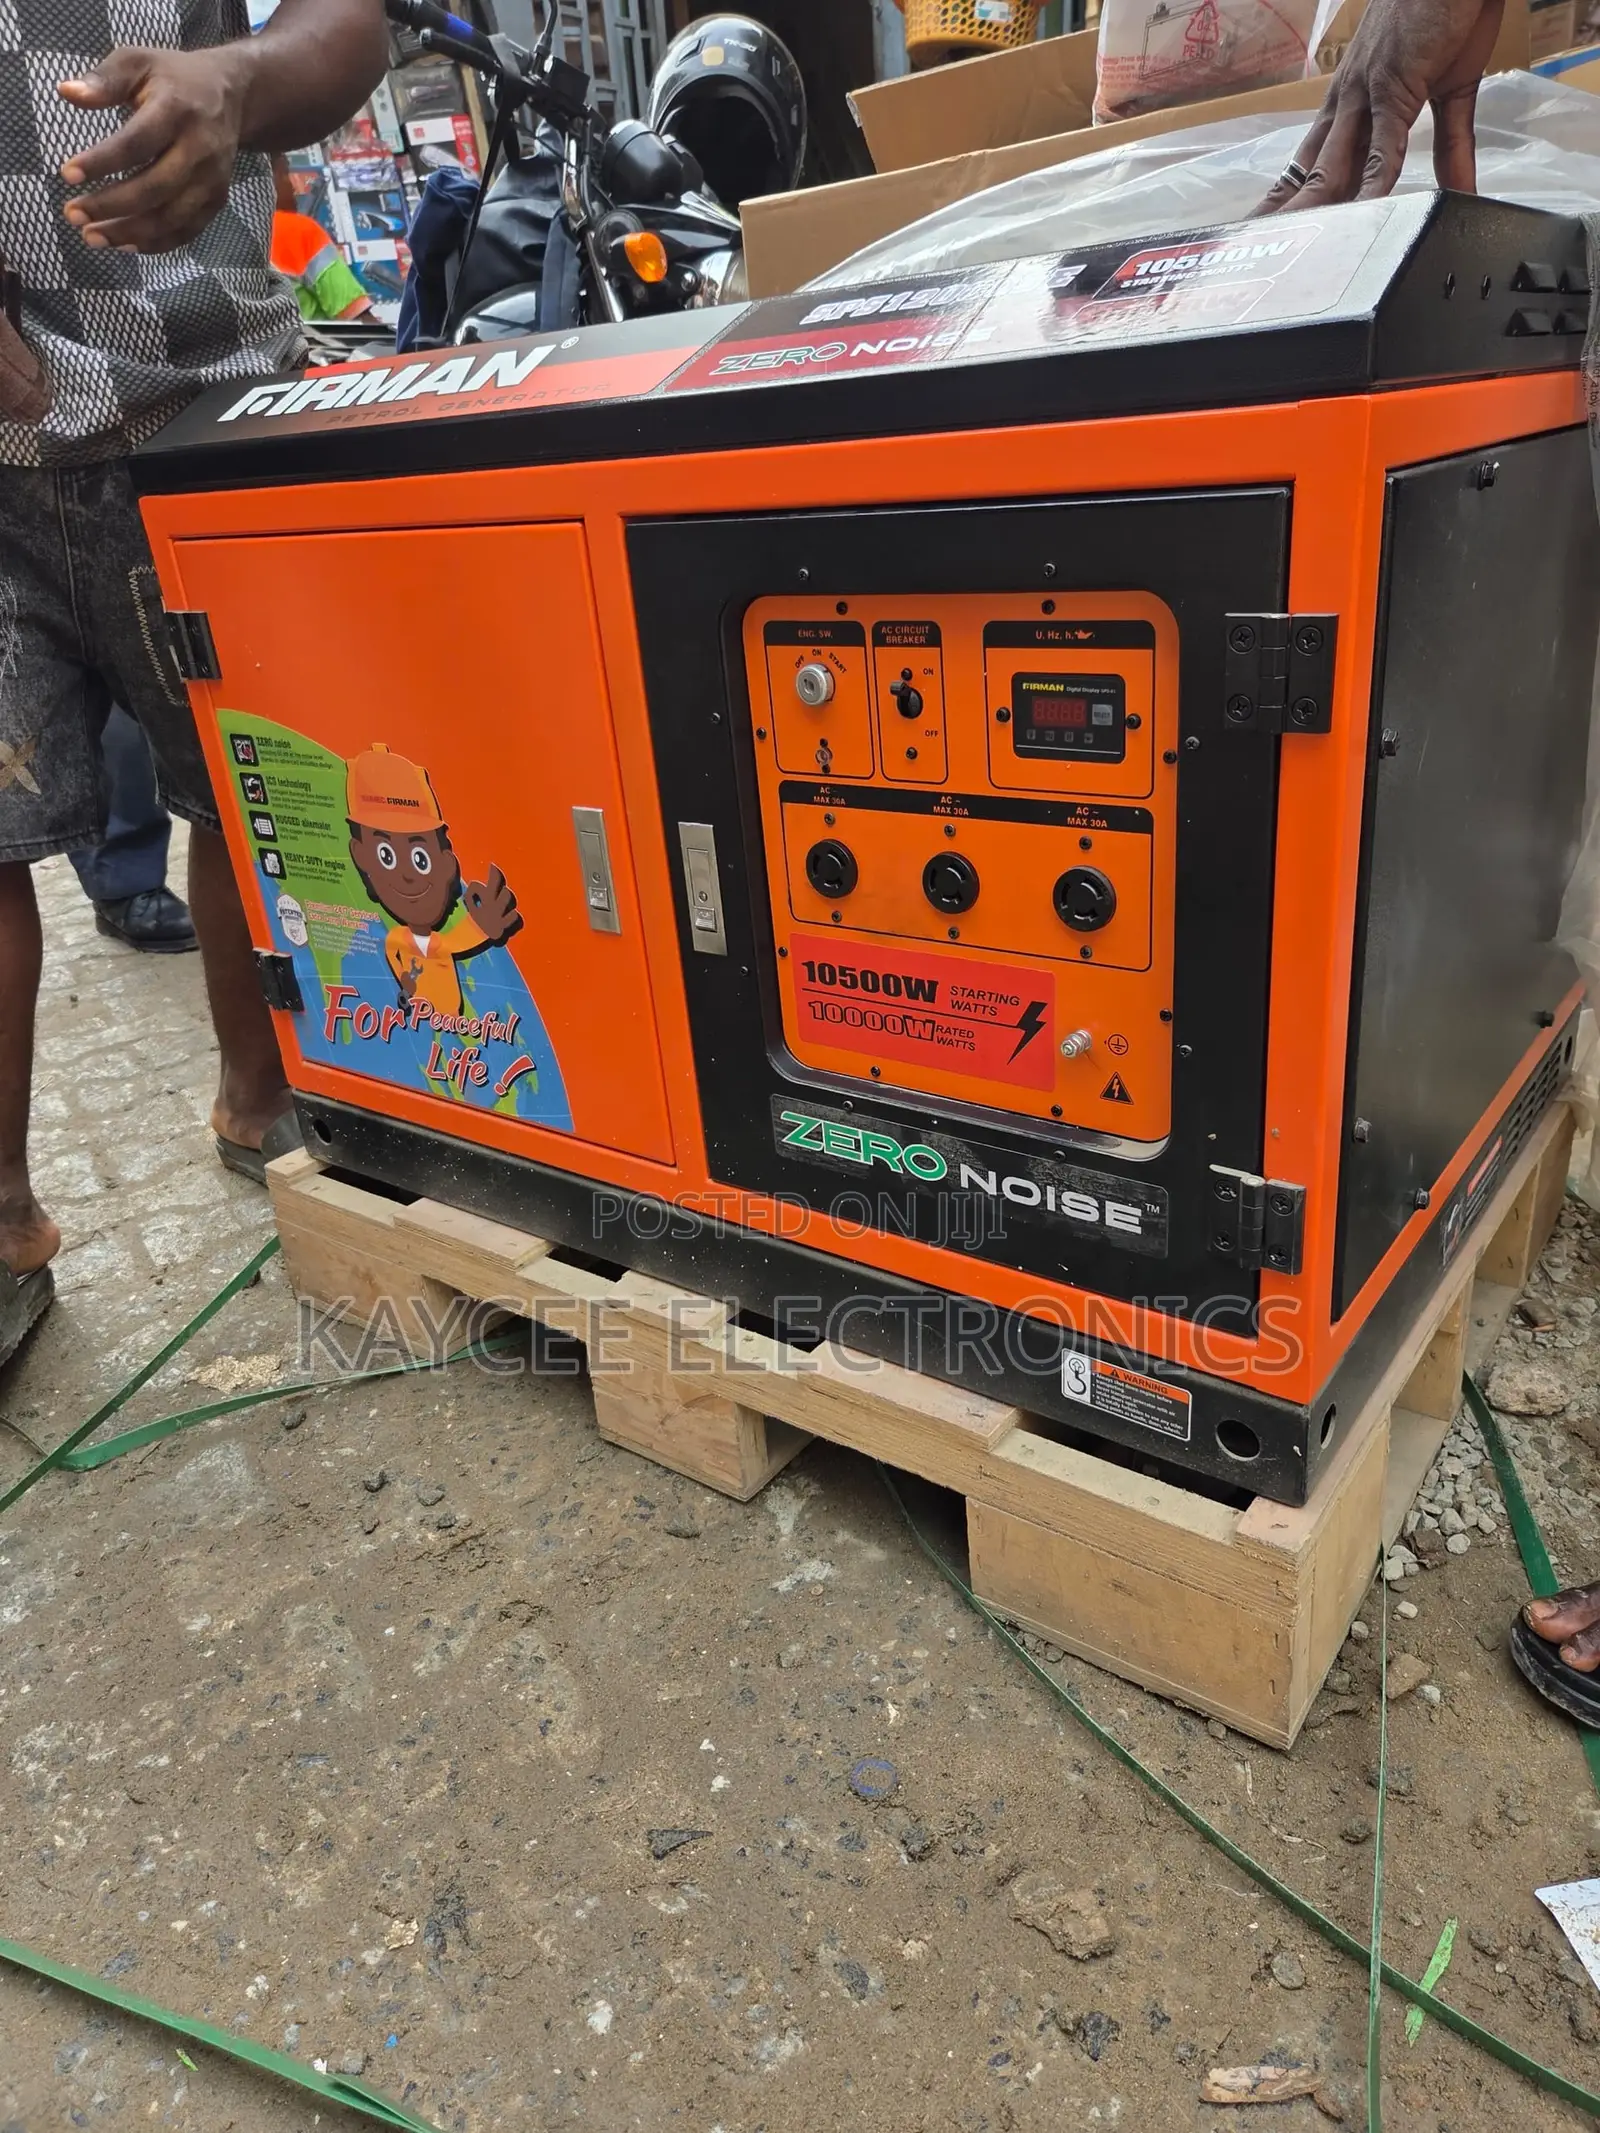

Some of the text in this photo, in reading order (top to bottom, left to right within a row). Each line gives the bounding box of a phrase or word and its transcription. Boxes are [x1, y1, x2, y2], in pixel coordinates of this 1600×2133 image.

[1133, 240, 1295, 276] 10500W
[1120, 271, 1197, 289] STARTING
[709, 326, 998, 376] ZERO NOISE
[217, 343, 557, 423] FIRMAN
[325, 383, 613, 424] PETROL GENERATOR
[798, 629, 834, 639] ENG. SW.
[881, 625, 930, 635] AC CIRCUIT
[886, 635, 927, 644] BREAKER
[812, 649, 822, 657] ON
[794, 655, 805, 669] OFF
[828, 652, 848, 674] START
[923, 668, 934, 676] ON
[1022, 682, 1065, 692] FIRMAN
[925, 729, 938, 737] OFF
[277, 777, 312, 793] technology
[819, 786, 831, 795] AC
[386, 797, 420, 807] FIRMAN
[813, 795, 846, 806] MAX 30A
[940, 796, 953, 805] AC
[933, 805, 969, 817] MAX 30A
[1076, 807, 1090, 816] AC
[274, 813, 300, 826] RUGGED
[1067, 816, 1108, 828] MAX 30A
[283, 851, 346, 871] HEAVY-DUTY engine
[801, 960, 939, 1004] 10500W
[949, 985, 1021, 1006] STARTING
[324, 984, 519, 1047] For Peaceful
[951, 999, 998, 1017] WATTS
[808, 1001, 936, 1041] 10000W
[936, 1024, 975, 1039] RATED
[936, 1036, 976, 1051] WATTS
[780, 1110, 948, 1182] ZERO
[959, 1163, 1143, 1235] NOISE
[1124, 1373, 1168, 1394] WARNING
